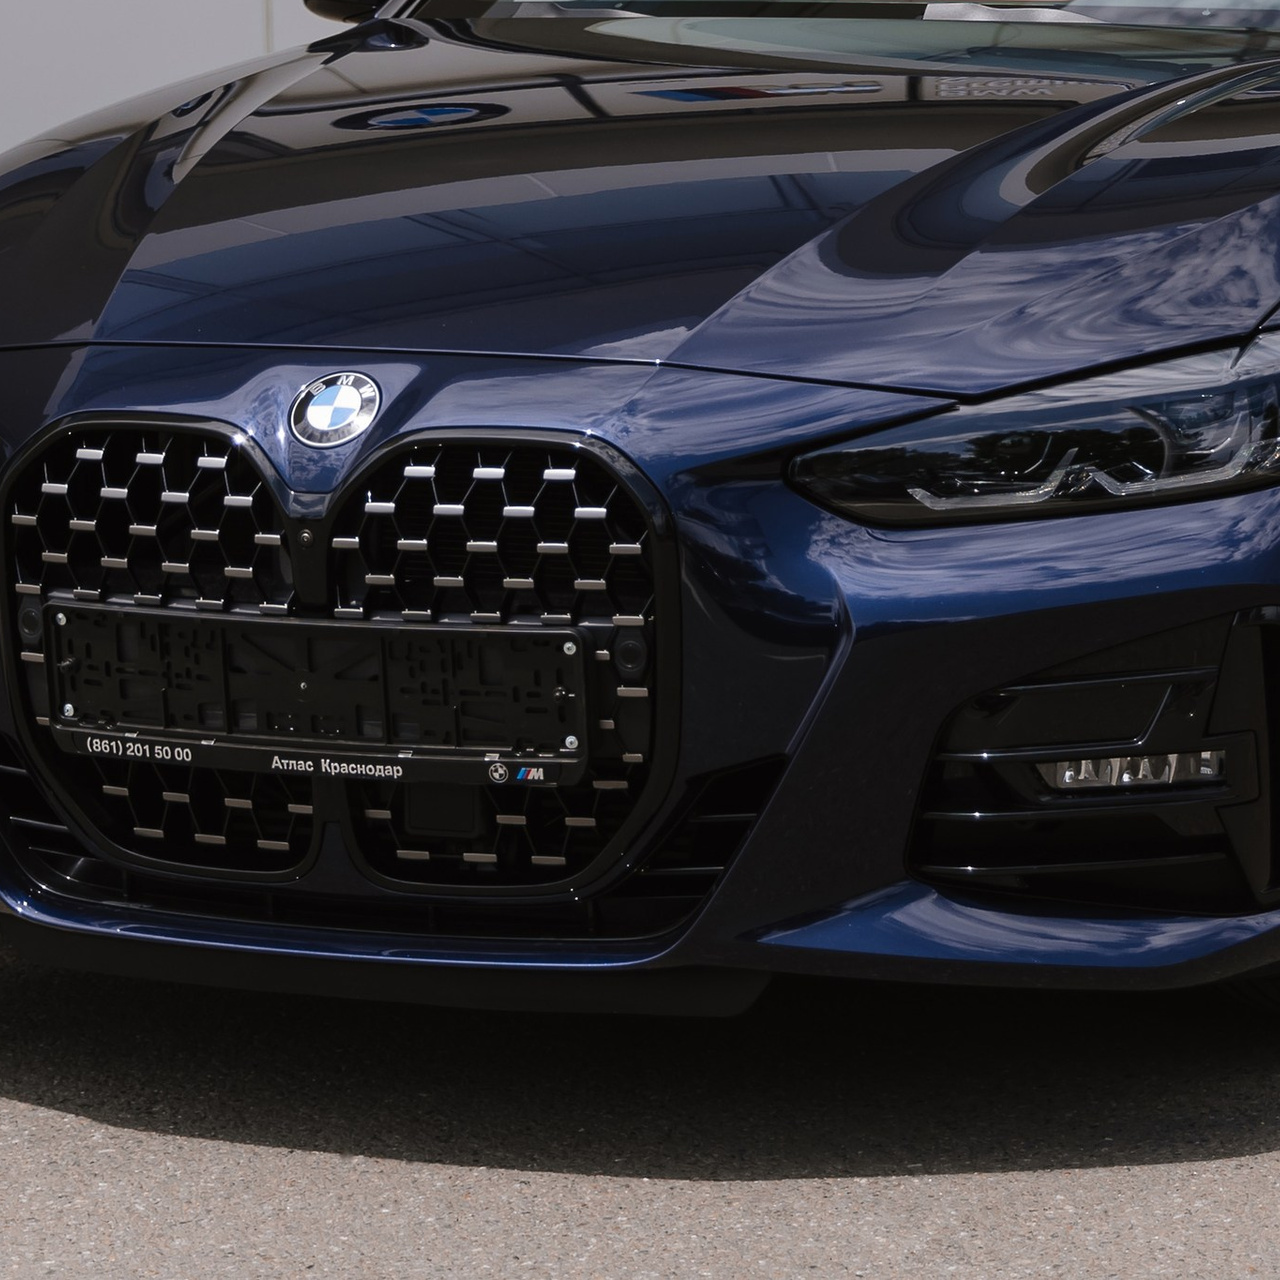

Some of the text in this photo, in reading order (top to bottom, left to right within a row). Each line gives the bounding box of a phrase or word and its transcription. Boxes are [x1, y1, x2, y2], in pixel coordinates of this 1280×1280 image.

[309, 375, 375, 398] BMW
[87, 736, 192, 762] (861) 201 50 00
[271, 755, 403, 779] Атлас Краснодар
